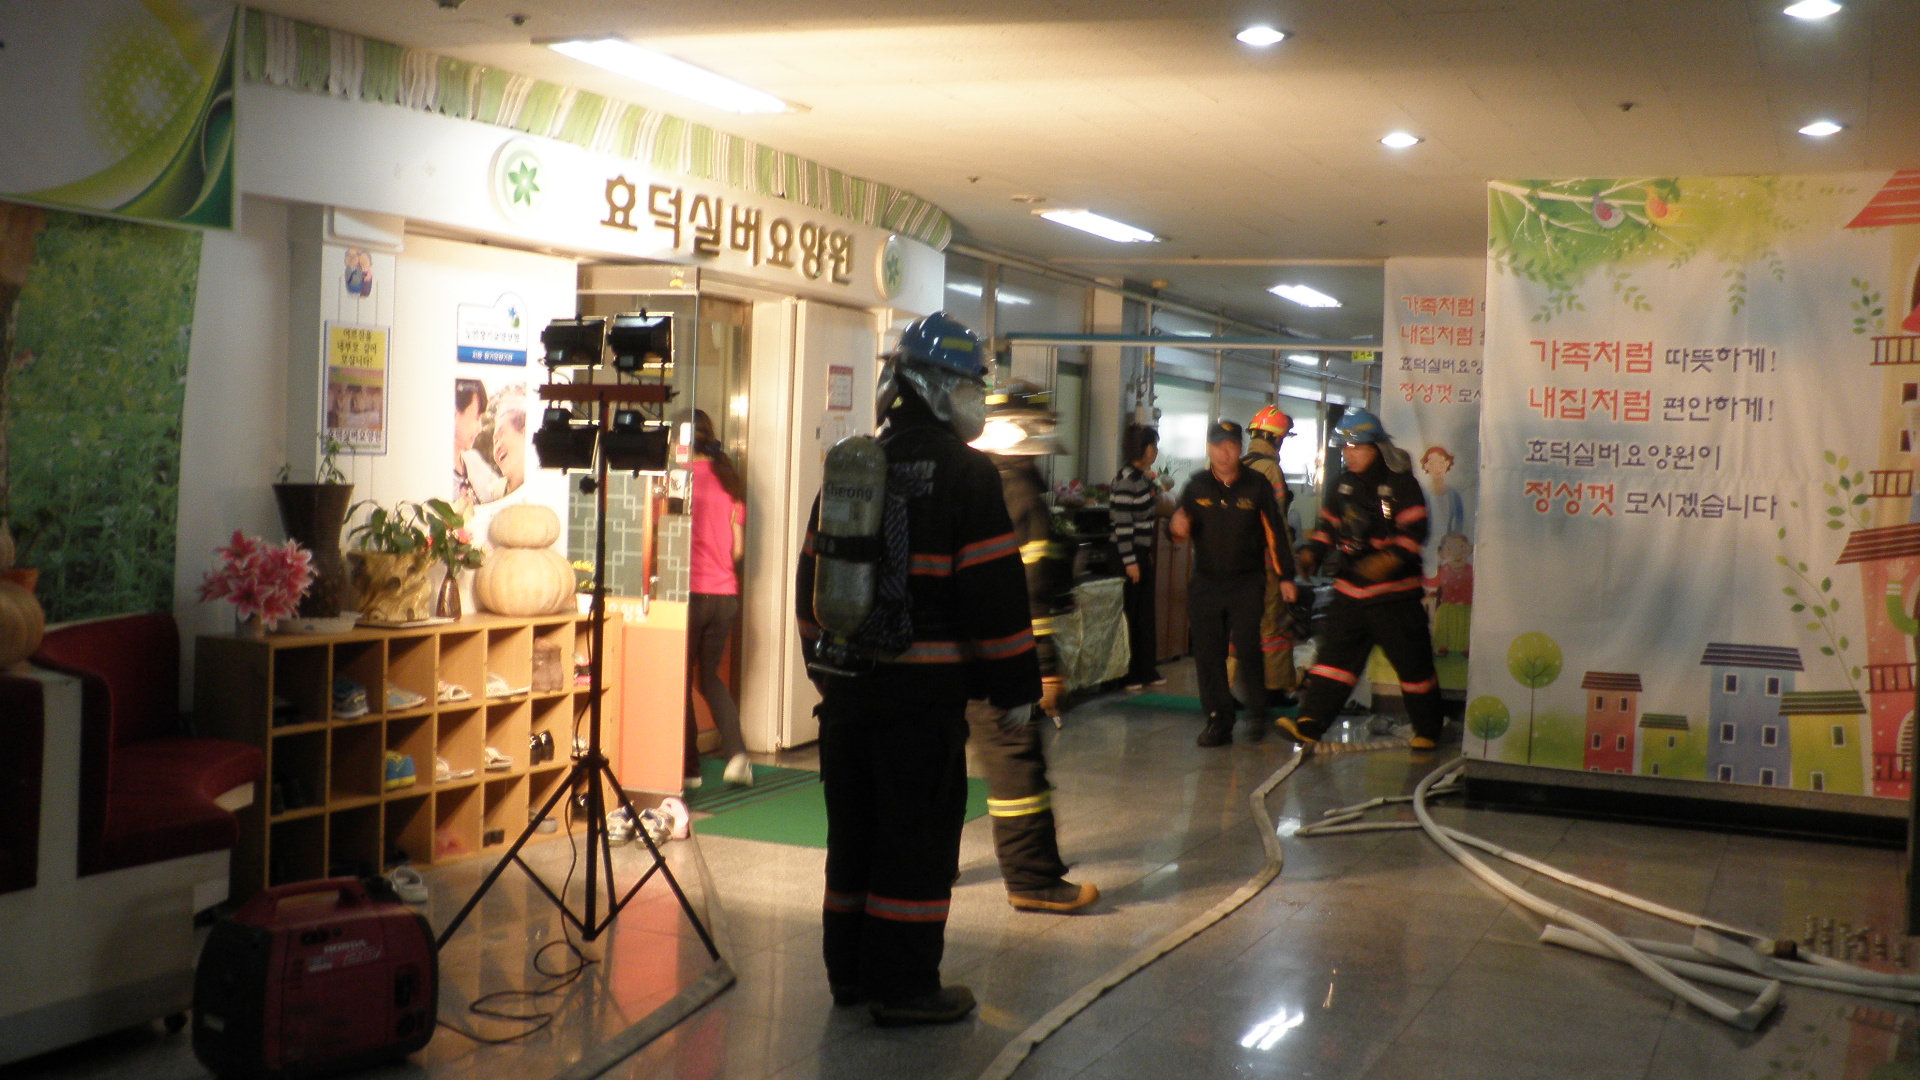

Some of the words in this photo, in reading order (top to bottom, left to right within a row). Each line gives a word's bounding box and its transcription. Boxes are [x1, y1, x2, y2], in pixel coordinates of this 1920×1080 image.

[1402, 296, 1474, 317] 가족처럼
[1401, 324, 1473, 347] 내집처럼
[1529, 340, 1653, 373] 가족처럼
[1665, 347, 1776, 373] 따뜻하게!
[1399, 383, 1453, 404] 정성껏
[1529, 386, 1651, 421] 내집처럼
[1663, 396, 1774, 422] 편안하게!
[1525, 440, 1720, 470] 효덕실버요양원이
[1525, 481, 1614, 516] 정성껏
[1625, 492, 1777, 520] 모시겠습니다
